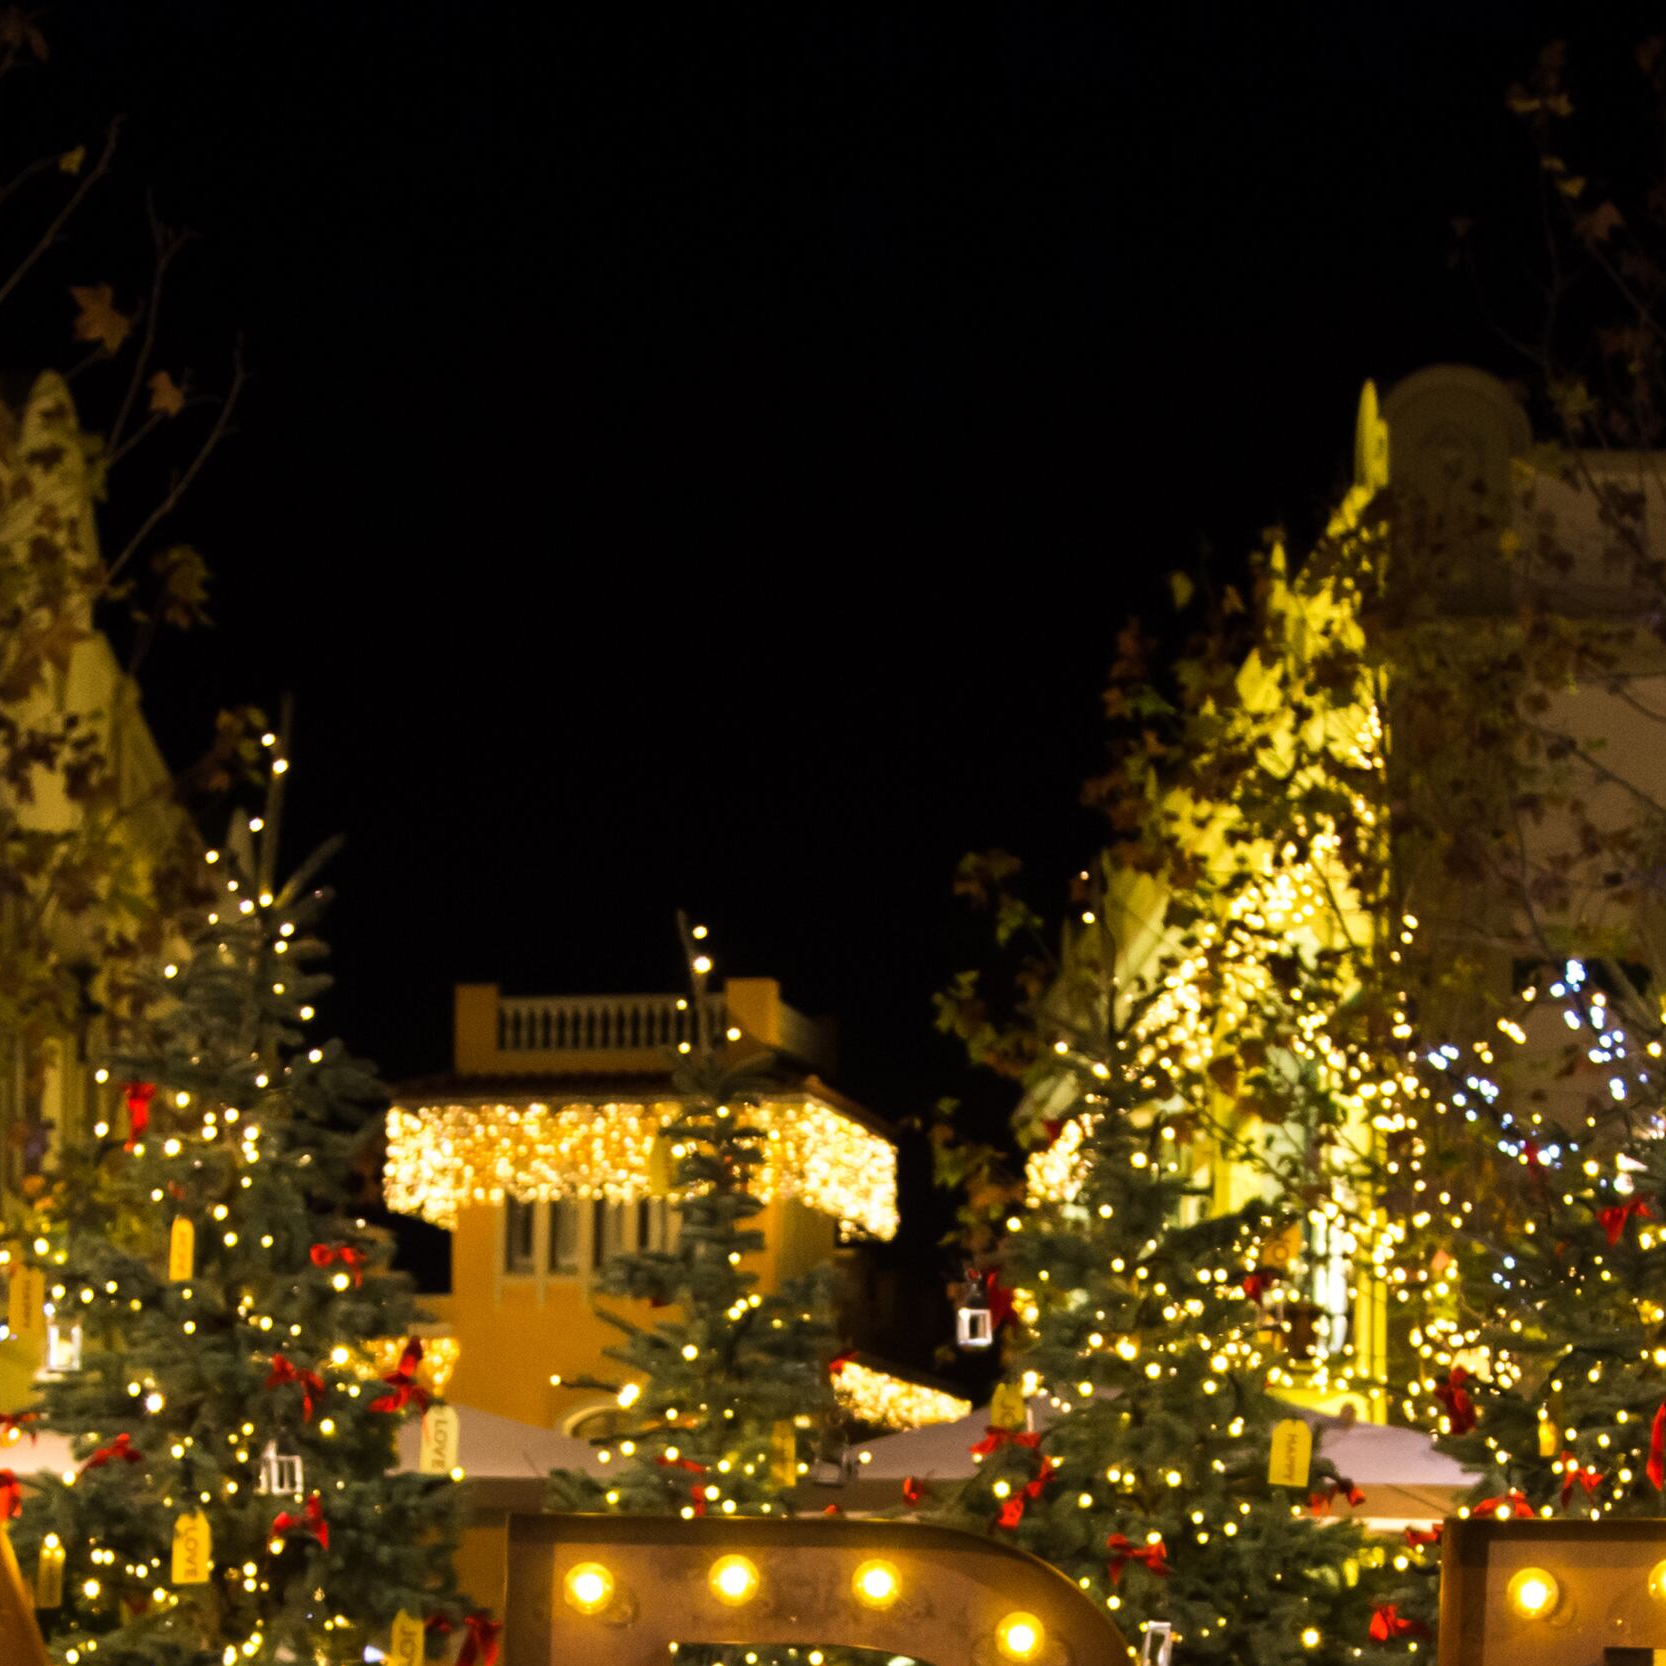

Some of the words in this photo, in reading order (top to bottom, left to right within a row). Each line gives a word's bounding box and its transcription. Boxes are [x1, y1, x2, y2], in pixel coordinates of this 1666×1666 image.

[431, 1419, 448, 1472] LOVE
[1282, 1433, 1298, 1481] HAPPY
[183, 1526, 200, 1580] LOVE
